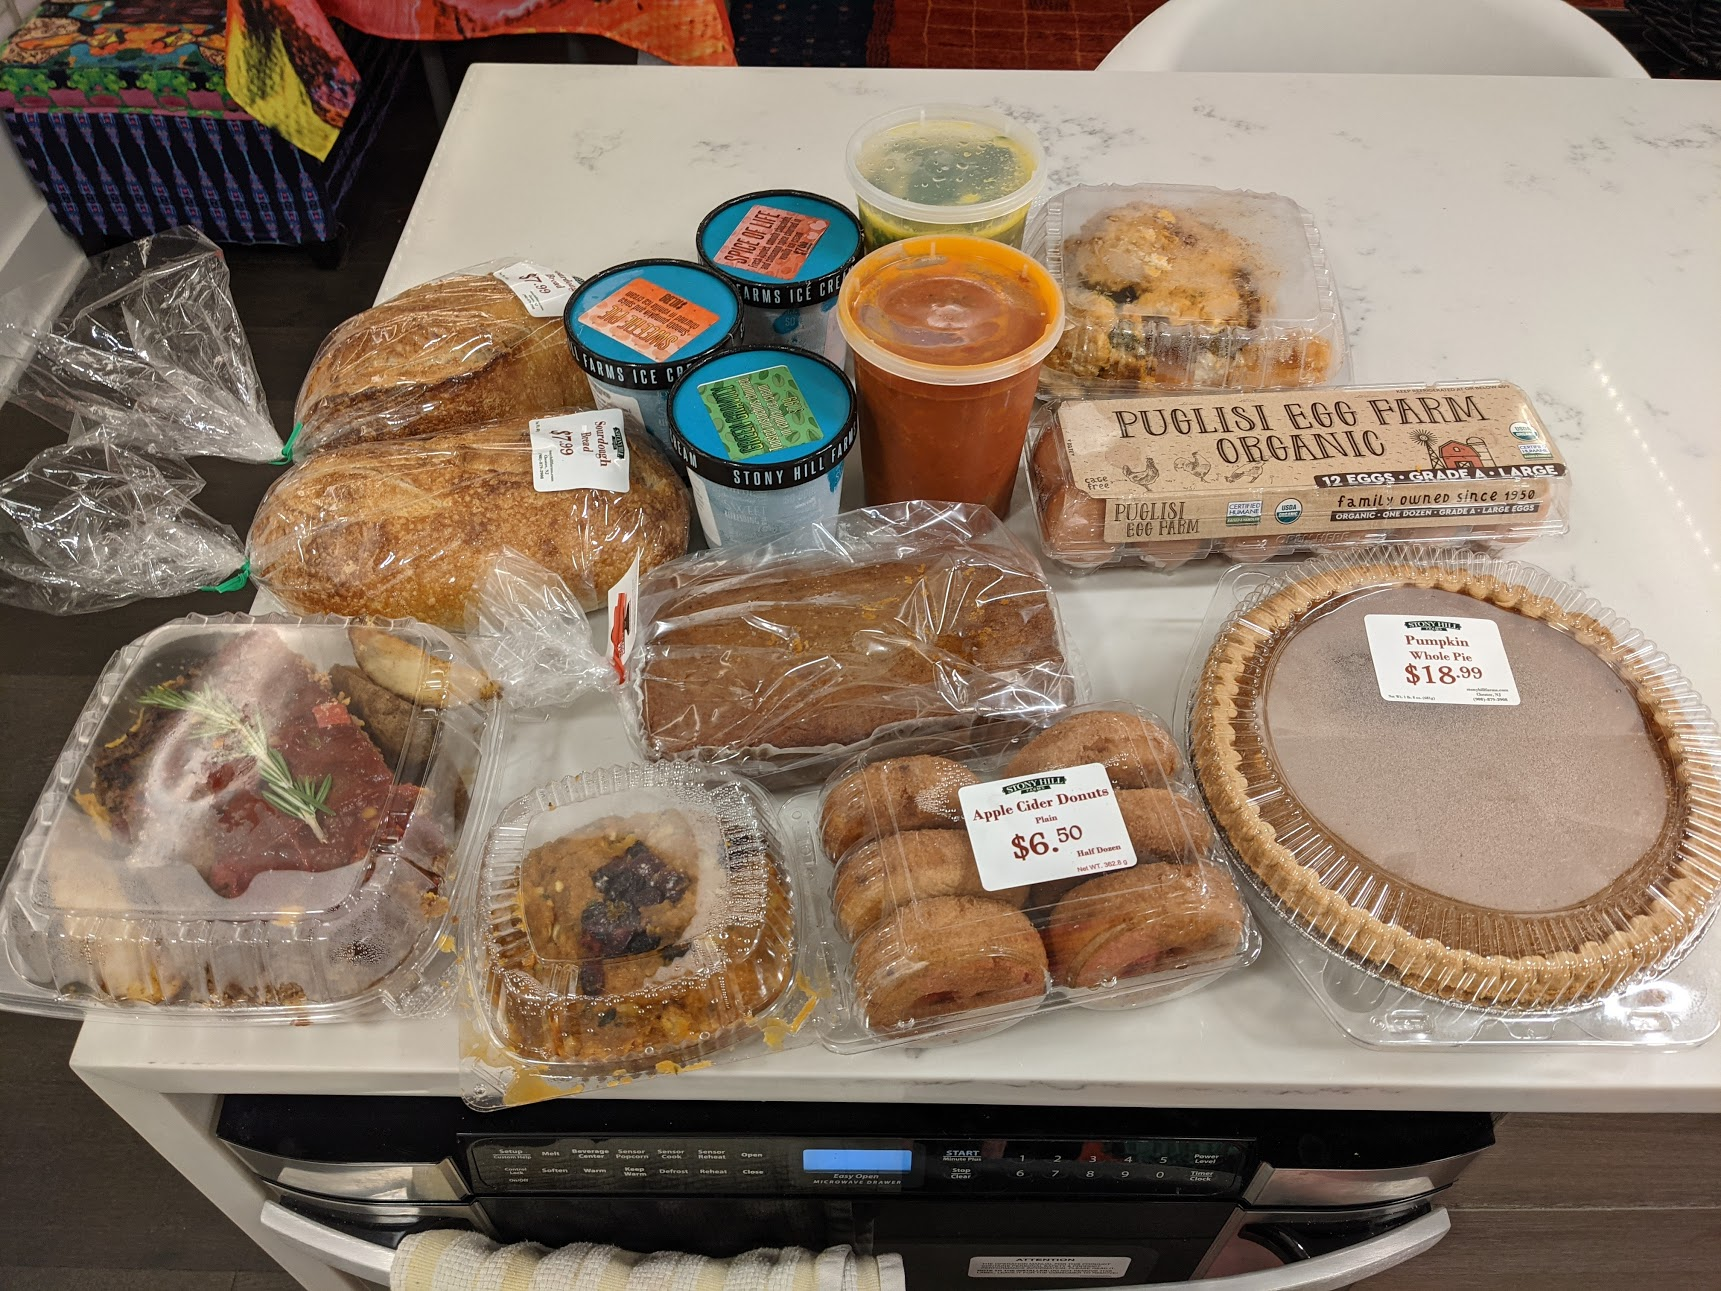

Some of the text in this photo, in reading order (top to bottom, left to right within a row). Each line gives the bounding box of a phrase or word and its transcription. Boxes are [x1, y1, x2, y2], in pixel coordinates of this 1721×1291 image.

[750, 210, 779, 228] LIFE
[741, 227, 767, 239] OF
[724, 238, 759, 263] SPICE
[518, 273, 551, 294] $7.99
[736, 284, 812, 304] ARMS ICE
[597, 305, 677, 350] SWEETIE PIE
[583, 354, 625, 382] FARMS
[633, 369, 658, 385] ICE
[1112, 396, 1491, 438] PUGLISI EGG FARM
[549, 430, 574, 456] $7.99
[580, 432, 594, 453] Bread
[594, 421, 612, 467] Sourdough
[728, 421, 763, 452] GREEN
[761, 428, 783, 450] Toasted
[734, 470, 784, 487] STONY
[794, 457, 825, 481] HILL
[832, 421, 856, 463] FARMS
[1216, 430, 1385, 464] ORGANIC
[1088, 482, 1110, 490] free
[1322, 465, 1559, 488] 12 EGGS GRADE A LARGE
[1228, 502, 1261, 510] CERTIFIED
[1338, 494, 1393, 508] family
[1456, 489, 1497, 503] since
[1504, 490, 1536, 501] 1950
[1114, 502, 1185, 522] PUGLISI
[1335, 504, 1535, 521] ORGANIC ONE DOZEN GRADE A LARGE EGGS
[1126, 519, 1200, 538] EGG FARM
[1438, 622, 1460, 630] HILL
[1404, 634, 1470, 649] Pumpkin
[1409, 651, 1473, 662] Whole Pie
[1404, 663, 1483, 686] $18.99
[1006, 780, 1037, 793] STONY
[972, 788, 1110, 823] Apple Cider Donuts
[1035, 814, 1058, 825] Plain
[1011, 825, 1083, 861] $6.50
[1076, 844, 1122, 858] Half Dozen
[1077, 865, 1088, 873] Net
[1088, 863, 1103, 871] WT.
[1019, 1154, 1025, 1162] 1
[1053, 1155, 1062, 1163] 2
[1124, 1156, 1133, 1164] 4
[1159, 1156, 1168, 1164] 5
[1052, 1170, 1060, 1178] 7
[1086, 1170, 1095, 1178] 8
[1121, 1170, 1130, 1178] 9
[1156, 1171, 1165, 1179] 0
